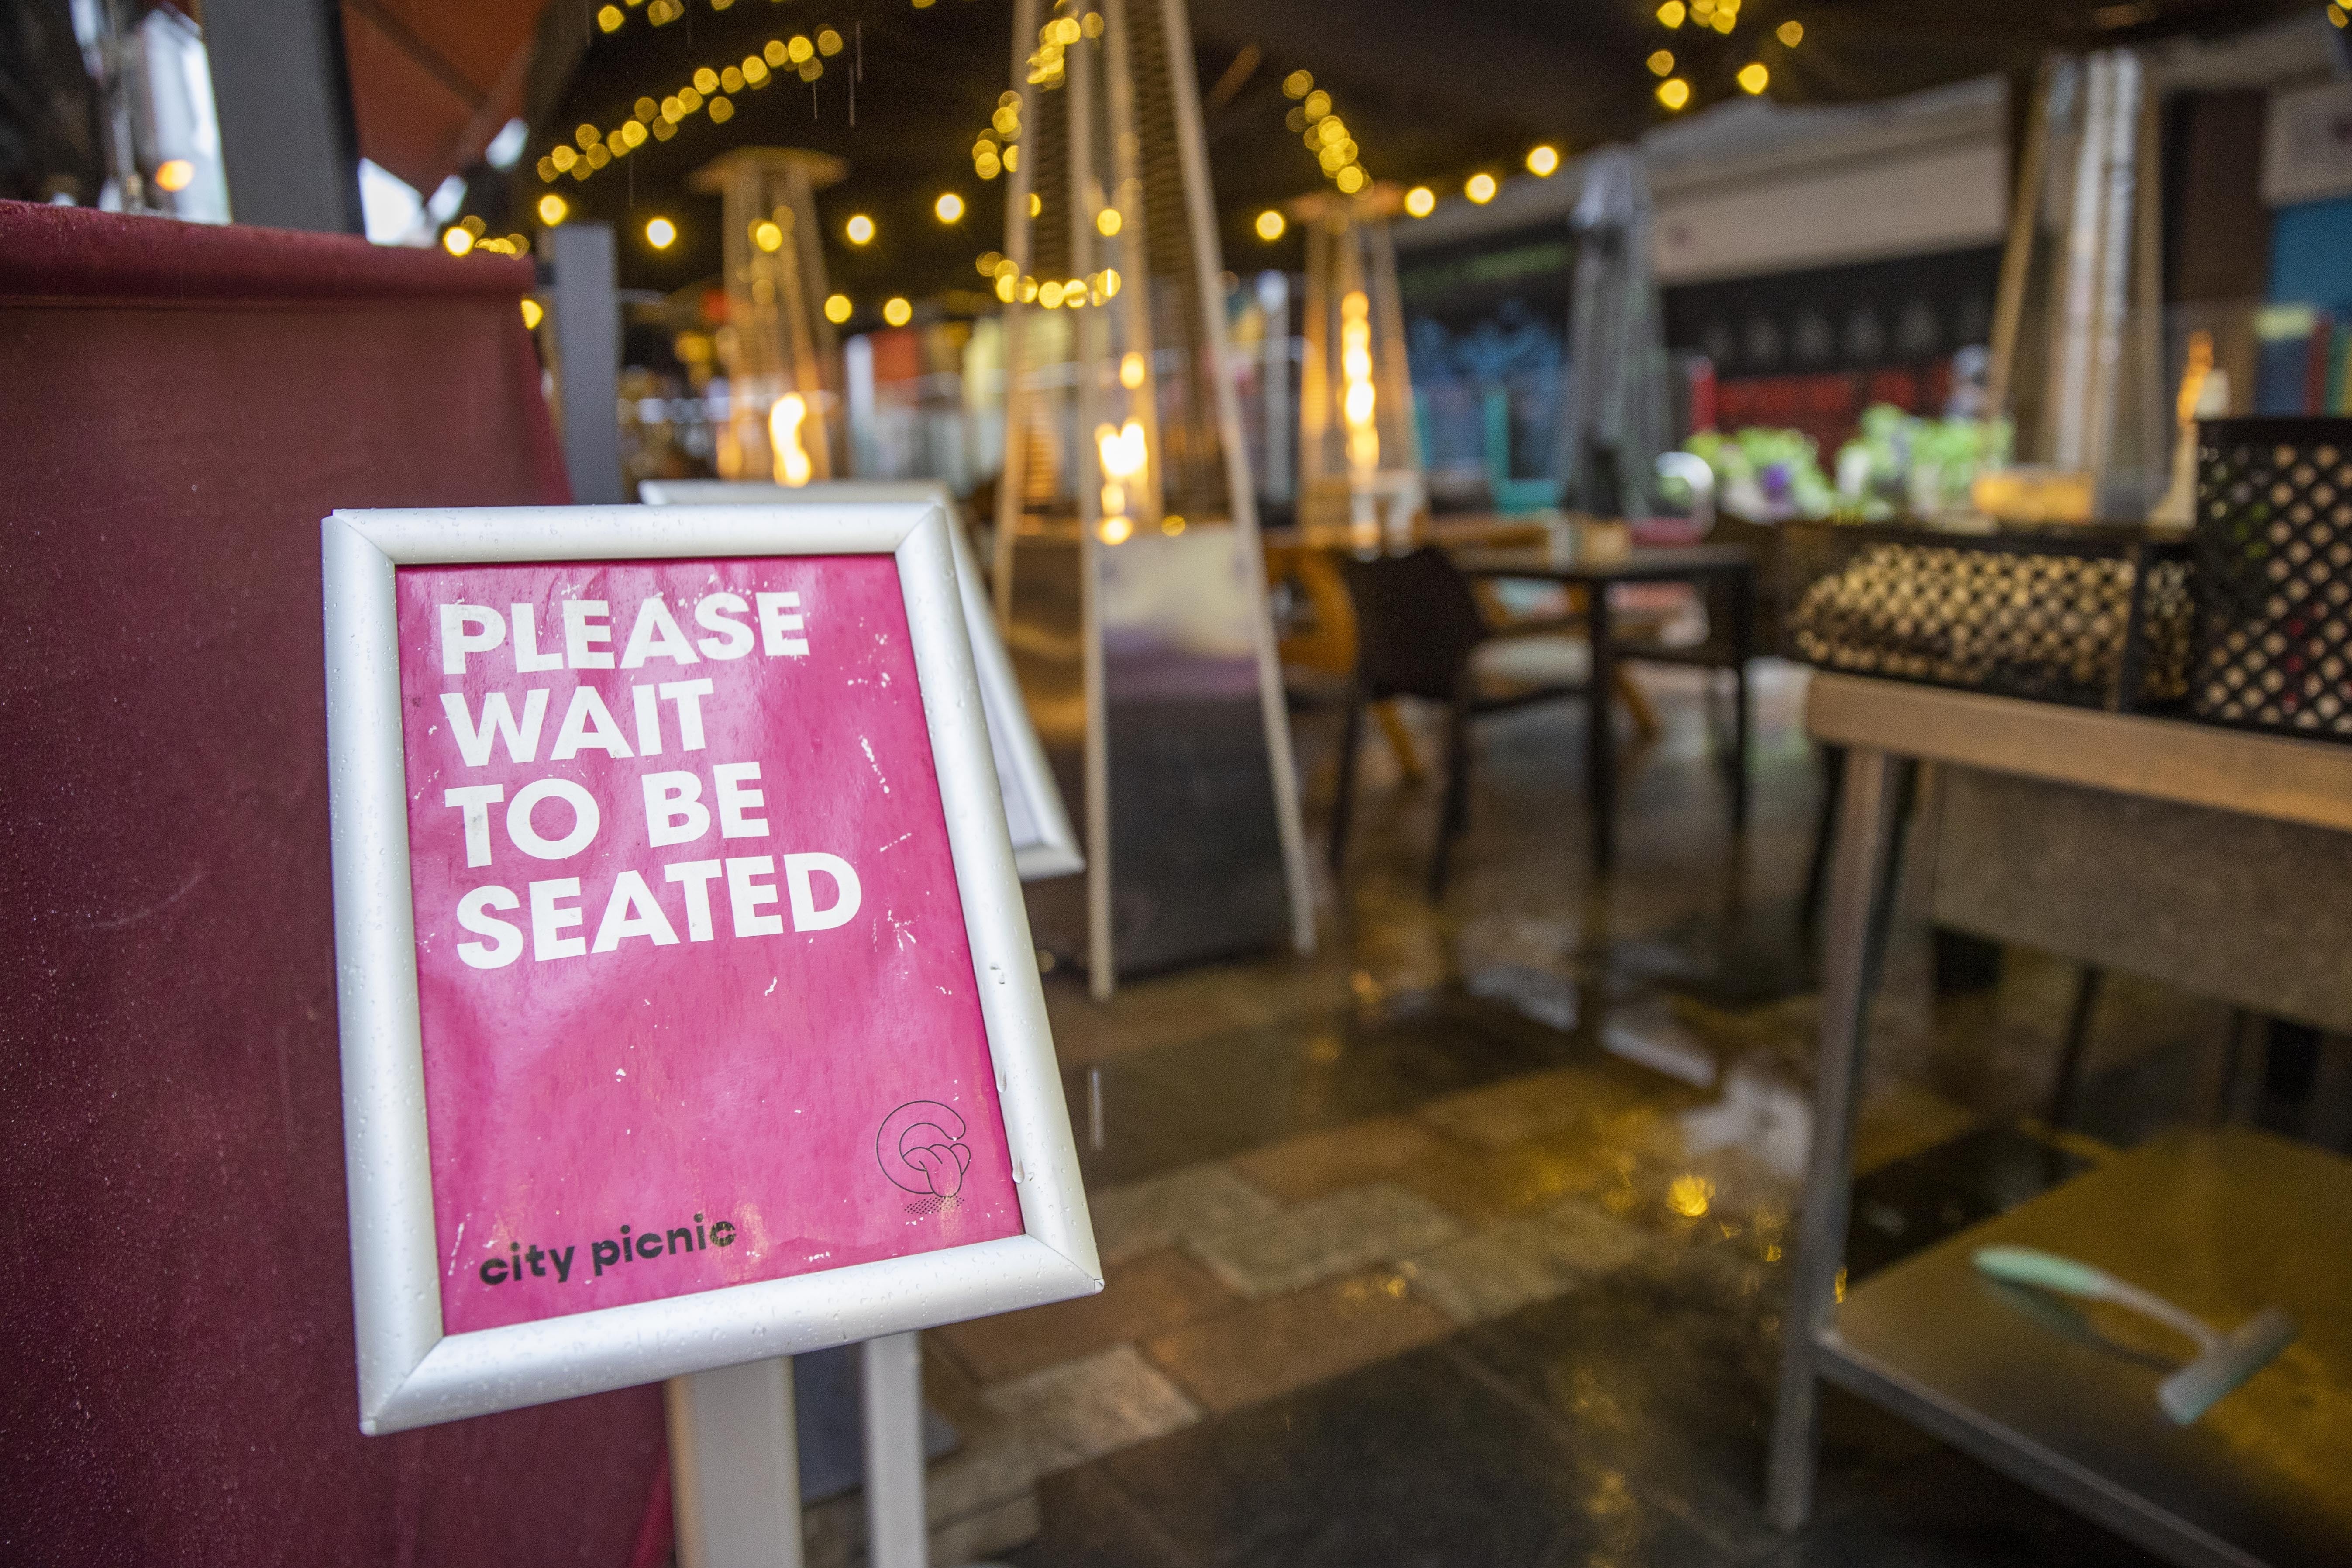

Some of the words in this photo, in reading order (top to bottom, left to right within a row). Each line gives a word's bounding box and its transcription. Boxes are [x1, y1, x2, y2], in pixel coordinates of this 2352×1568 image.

[439, 591, 810, 675] PLEASE
[439, 678, 714, 767] WAIT
[444, 778, 600, 868] TO
[641, 761, 770, 848] BE
[456, 851, 862, 970] SEATED
[480, 1242, 575, 1285] city
[591, 1213, 737, 1277] picnic
